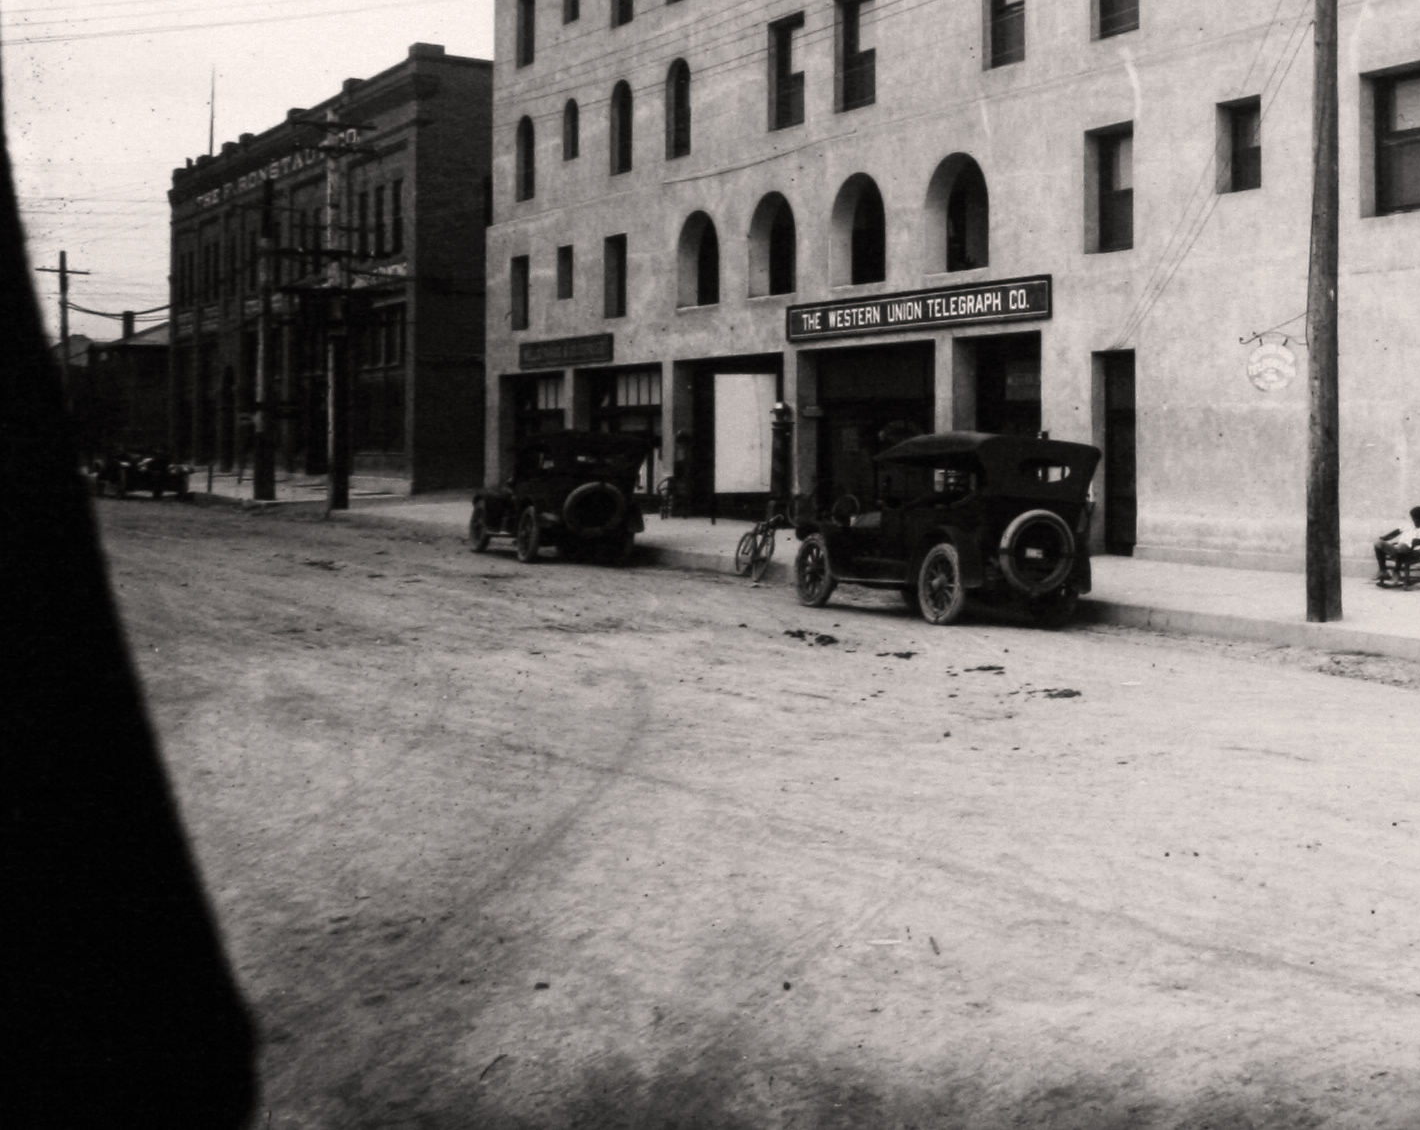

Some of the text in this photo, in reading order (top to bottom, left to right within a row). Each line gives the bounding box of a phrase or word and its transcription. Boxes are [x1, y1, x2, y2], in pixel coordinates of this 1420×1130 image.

[801, 288, 1030, 331] THE WESTERN UNION TELEGRAPH CO.
